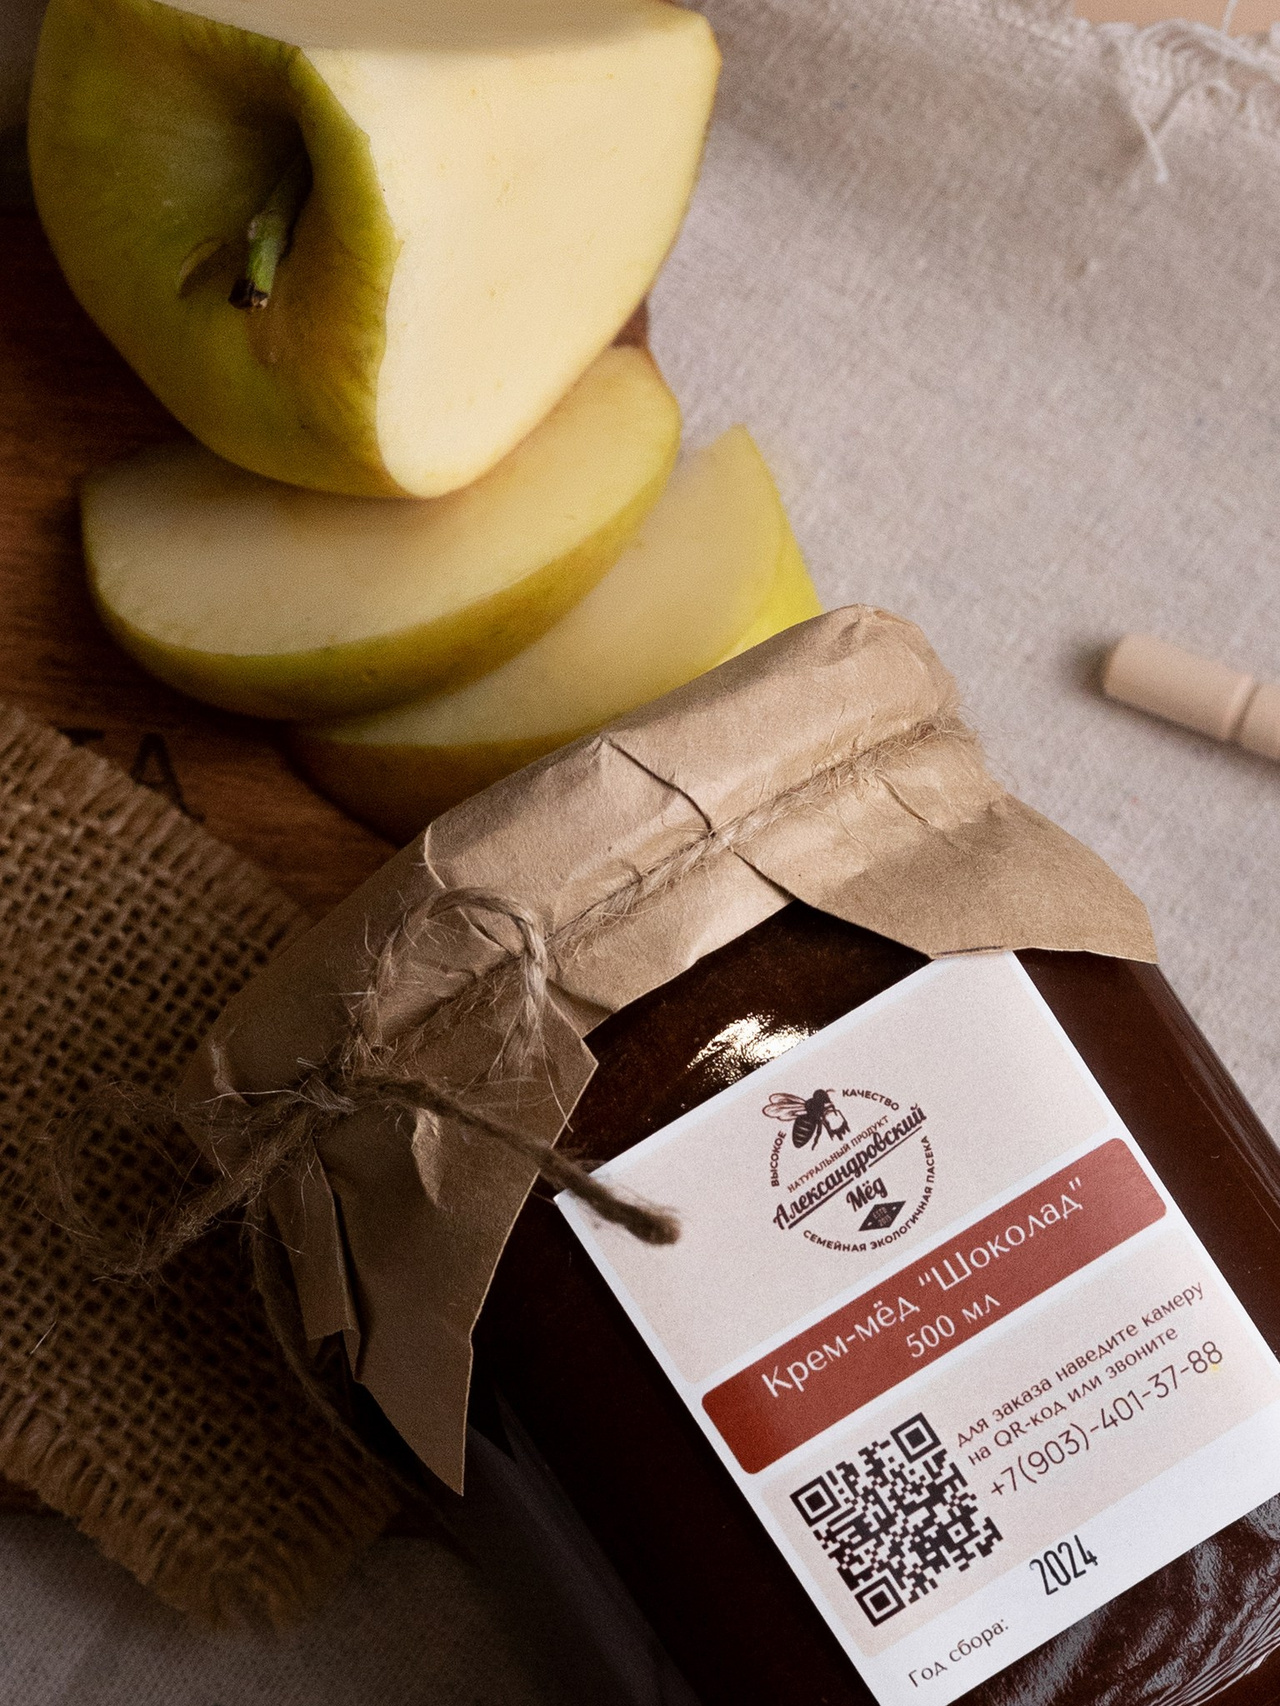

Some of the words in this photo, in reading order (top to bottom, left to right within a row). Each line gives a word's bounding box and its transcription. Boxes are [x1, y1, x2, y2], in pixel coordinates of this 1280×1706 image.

[771, 1130, 787, 1187] ВЫСОКОЕ
[842, 1089, 900, 1111] КАЧЕСТВО
[773, 1103, 927, 1230] Александровский
[787, 1142, 852, 1194] НАТУРАЛЬНЫЙ
[851, 1115, 889, 1147] ПРОДУКТ
[803, 1229, 867, 1252] СЕМЕЙНАЯ
[869, 1187, 933, 1251] ЭКОЛОГИЧНАЯ
[921, 1135, 935, 1184] ПАСЕКА
[846, 1177, 888, 1212] Мёд
[761, 1295, 920, 1399] Крем-мёд
[918, 1176, 1084, 1291] "Шоколад"
[906, 1315, 955, 1358] 500
[961, 1294, 1000, 1324] мл
[968, 1446, 991, 1467] на
[994, 1400, 1067, 1449] QR-код
[1067, 1375, 1103, 1403] или
[1105, 1326, 1179, 1381] звоните
[991, 1376, 1052, 1422] заказа
[1055, 1323, 1138, 1383] наведите
[1141, 1281, 1205, 1328] камеру
[990, 1340, 1223, 1498] +7(903)-401-37-88
[908, 1661, 948, 1688] Год
[948, 1618, 1009, 1663] сбора:
[1029, 1534, 1098, 1596] 2024
